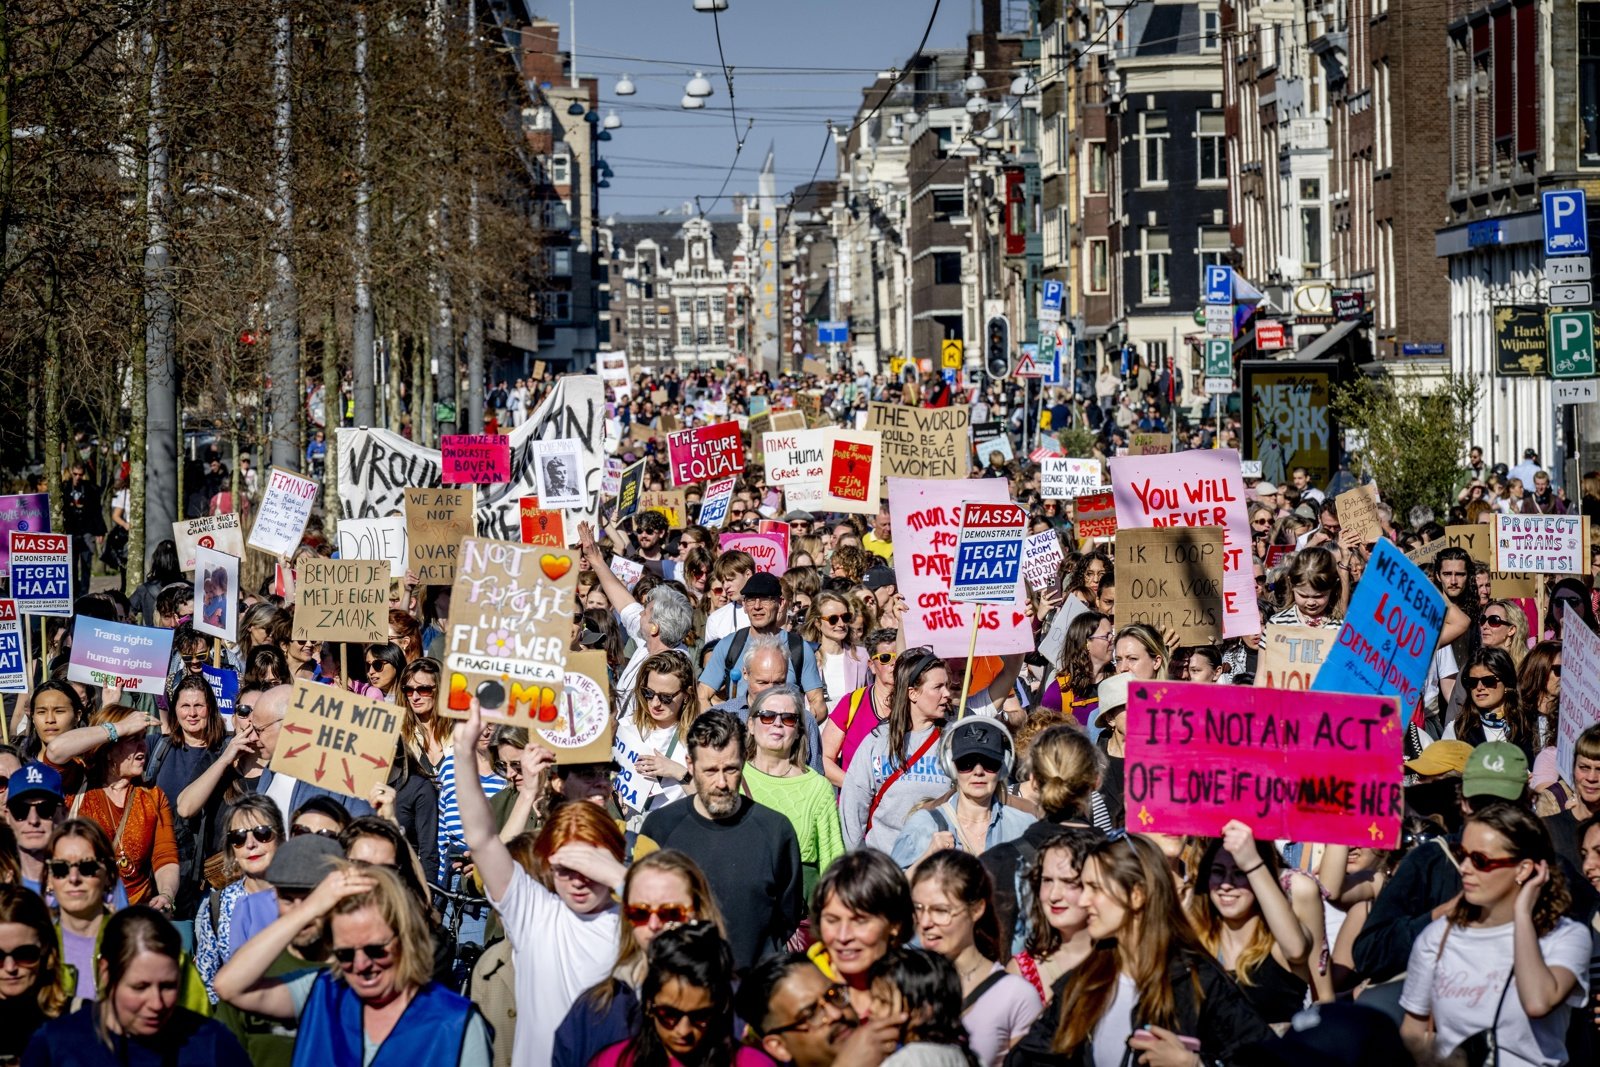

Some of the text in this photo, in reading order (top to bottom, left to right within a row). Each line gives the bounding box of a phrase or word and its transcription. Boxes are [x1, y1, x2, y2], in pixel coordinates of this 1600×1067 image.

[1552, 196, 1576, 228] P
[1552, 264, 1584, 274] 7-11 h
[1213, 269, 1227, 288] P
[1047, 283, 1059, 298] P
[1560, 318, 1583, 351] P
[1041, 337, 1053, 351] P
[1211, 341, 1226, 361] P
[1253, 384, 1313, 408] NEW
[1559, 387, 1591, 397] 11-7 h
[873, 405, 967, 432] THE WORLD
[1260, 406, 1328, 429] YORK
[442, 436, 507, 445] AL ER
[670, 430, 699, 447] THE
[690, 435, 738, 458] FUTURE
[766, 437, 798, 453] MAKE
[920, 435, 936, 446] BE
[944, 432, 954, 444] A
[1276, 428, 1330, 451] CITY
[788, 448, 824, 465] HUMA
[881, 442, 955, 458] ETTER PLACE
[454, 460, 495, 472] BOVEN
[679, 453, 743, 482] EQUAL
[889, 457, 956, 477] WOMEN
[1053, 461, 1067, 472] AM
[470, 472, 503, 482] VAN
[1065, 475, 1080, 485] YOU
[1081, 476, 1096, 486] ARE
[271, 472, 316, 501] FEMINISM
[708, 480, 733, 496] MASSA
[834, 486, 865, 499] TERUG!
[1065, 487, 1077, 495] WE
[410, 494, 429, 505] WE
[434, 495, 462, 506] ARE
[189, 514, 235, 529] SHAME MUST
[427, 510, 454, 520] NOT
[907, 506, 949, 532] men
[967, 508, 1023, 524] MASSA
[187, 520, 239, 536] CHANGE SIDES
[1080, 527, 1115, 537] SYSTE
[1501, 516, 1579, 534] PROTECT
[930, 531, 957, 553] fro
[965, 529, 1022, 539] DEMONSTRATIE
[1028, 530, 1056, 547] VROEG
[1449, 533, 1475, 549] MY
[1511, 534, 1562, 551] TRANS
[14, 539, 66, 551] MASSA
[415, 544, 460, 559] OVAR
[963, 543, 1018, 560] TEGEN
[1129, 542, 1214, 564] IK LOOP
[461, 539, 537, 578] NOT
[16, 567, 66, 580] TEGEN
[364, 566, 381, 585] JE
[961, 560, 1017, 580] HAAT
[17, 581, 67, 595] HAAT
[1131, 578, 1220, 599] OOK VOOR
[1376, 551, 1443, 632] WE'RE BEING
[303, 588, 384, 606] MET JE EIGEN
[316, 609, 376, 629] ZA(A)K
[480, 614, 536, 633] LIKE A
[922, 607, 1000, 631] with us
[1374, 593, 1426, 657] LOUD
[94, 628, 153, 646] Trans rights
[1564, 623, 1584, 661] TRANS
[113, 646, 130, 655] are
[1382, 640, 1391, 653] &
[87, 651, 152, 670] human rights
[456, 657, 556, 679] FRAGILE LIKE A
[1338, 623, 1418, 705] DEMANDING
[294, 688, 308, 709] I
[310, 694, 344, 720] AM
[1146, 706, 1379, 750] IT'S NOT AN ACT
[317, 724, 358, 756] HER
[26, 766, 43, 783] LA
[1129, 762, 1166, 803] OF
[1169, 767, 1227, 804] LOVE
[1299, 774, 1357, 810] MAKE
[1360, 779, 1402, 816] HER
